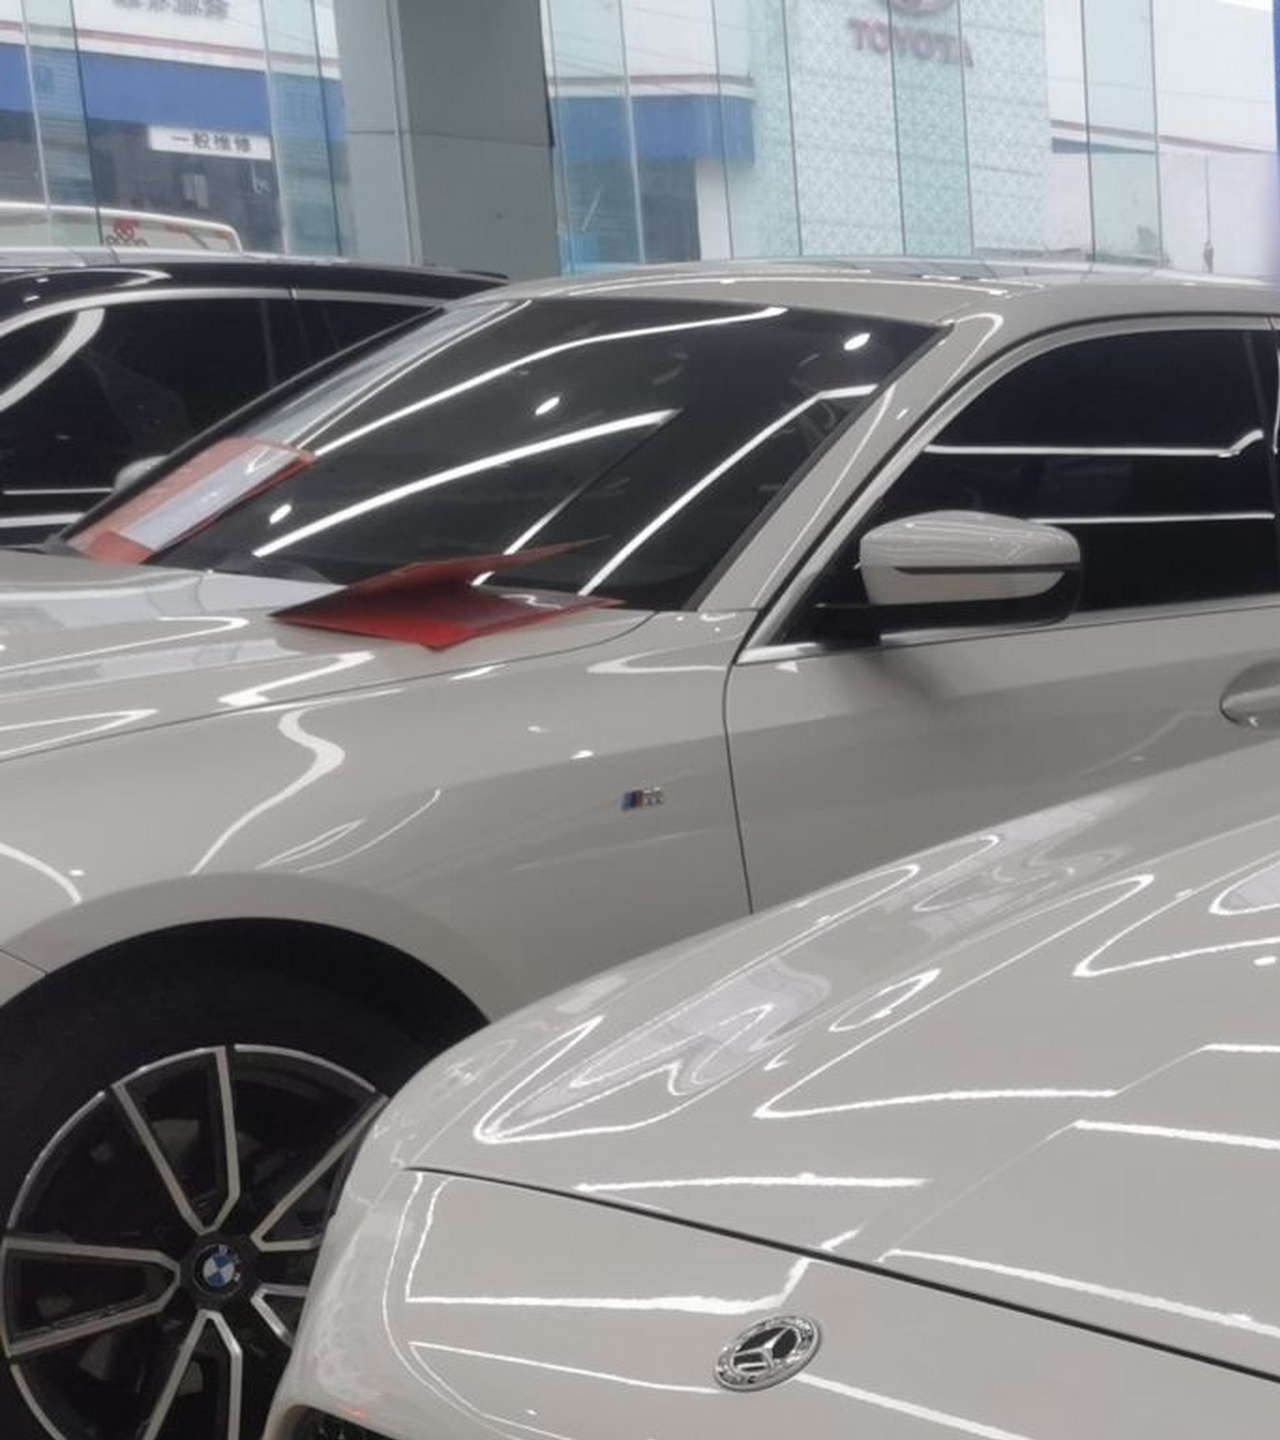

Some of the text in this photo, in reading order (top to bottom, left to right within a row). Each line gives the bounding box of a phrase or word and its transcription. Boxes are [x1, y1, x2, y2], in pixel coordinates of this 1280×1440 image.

[847, 18, 974, 68] TOYOTA
[171, 132, 252, 153] 一般维修
